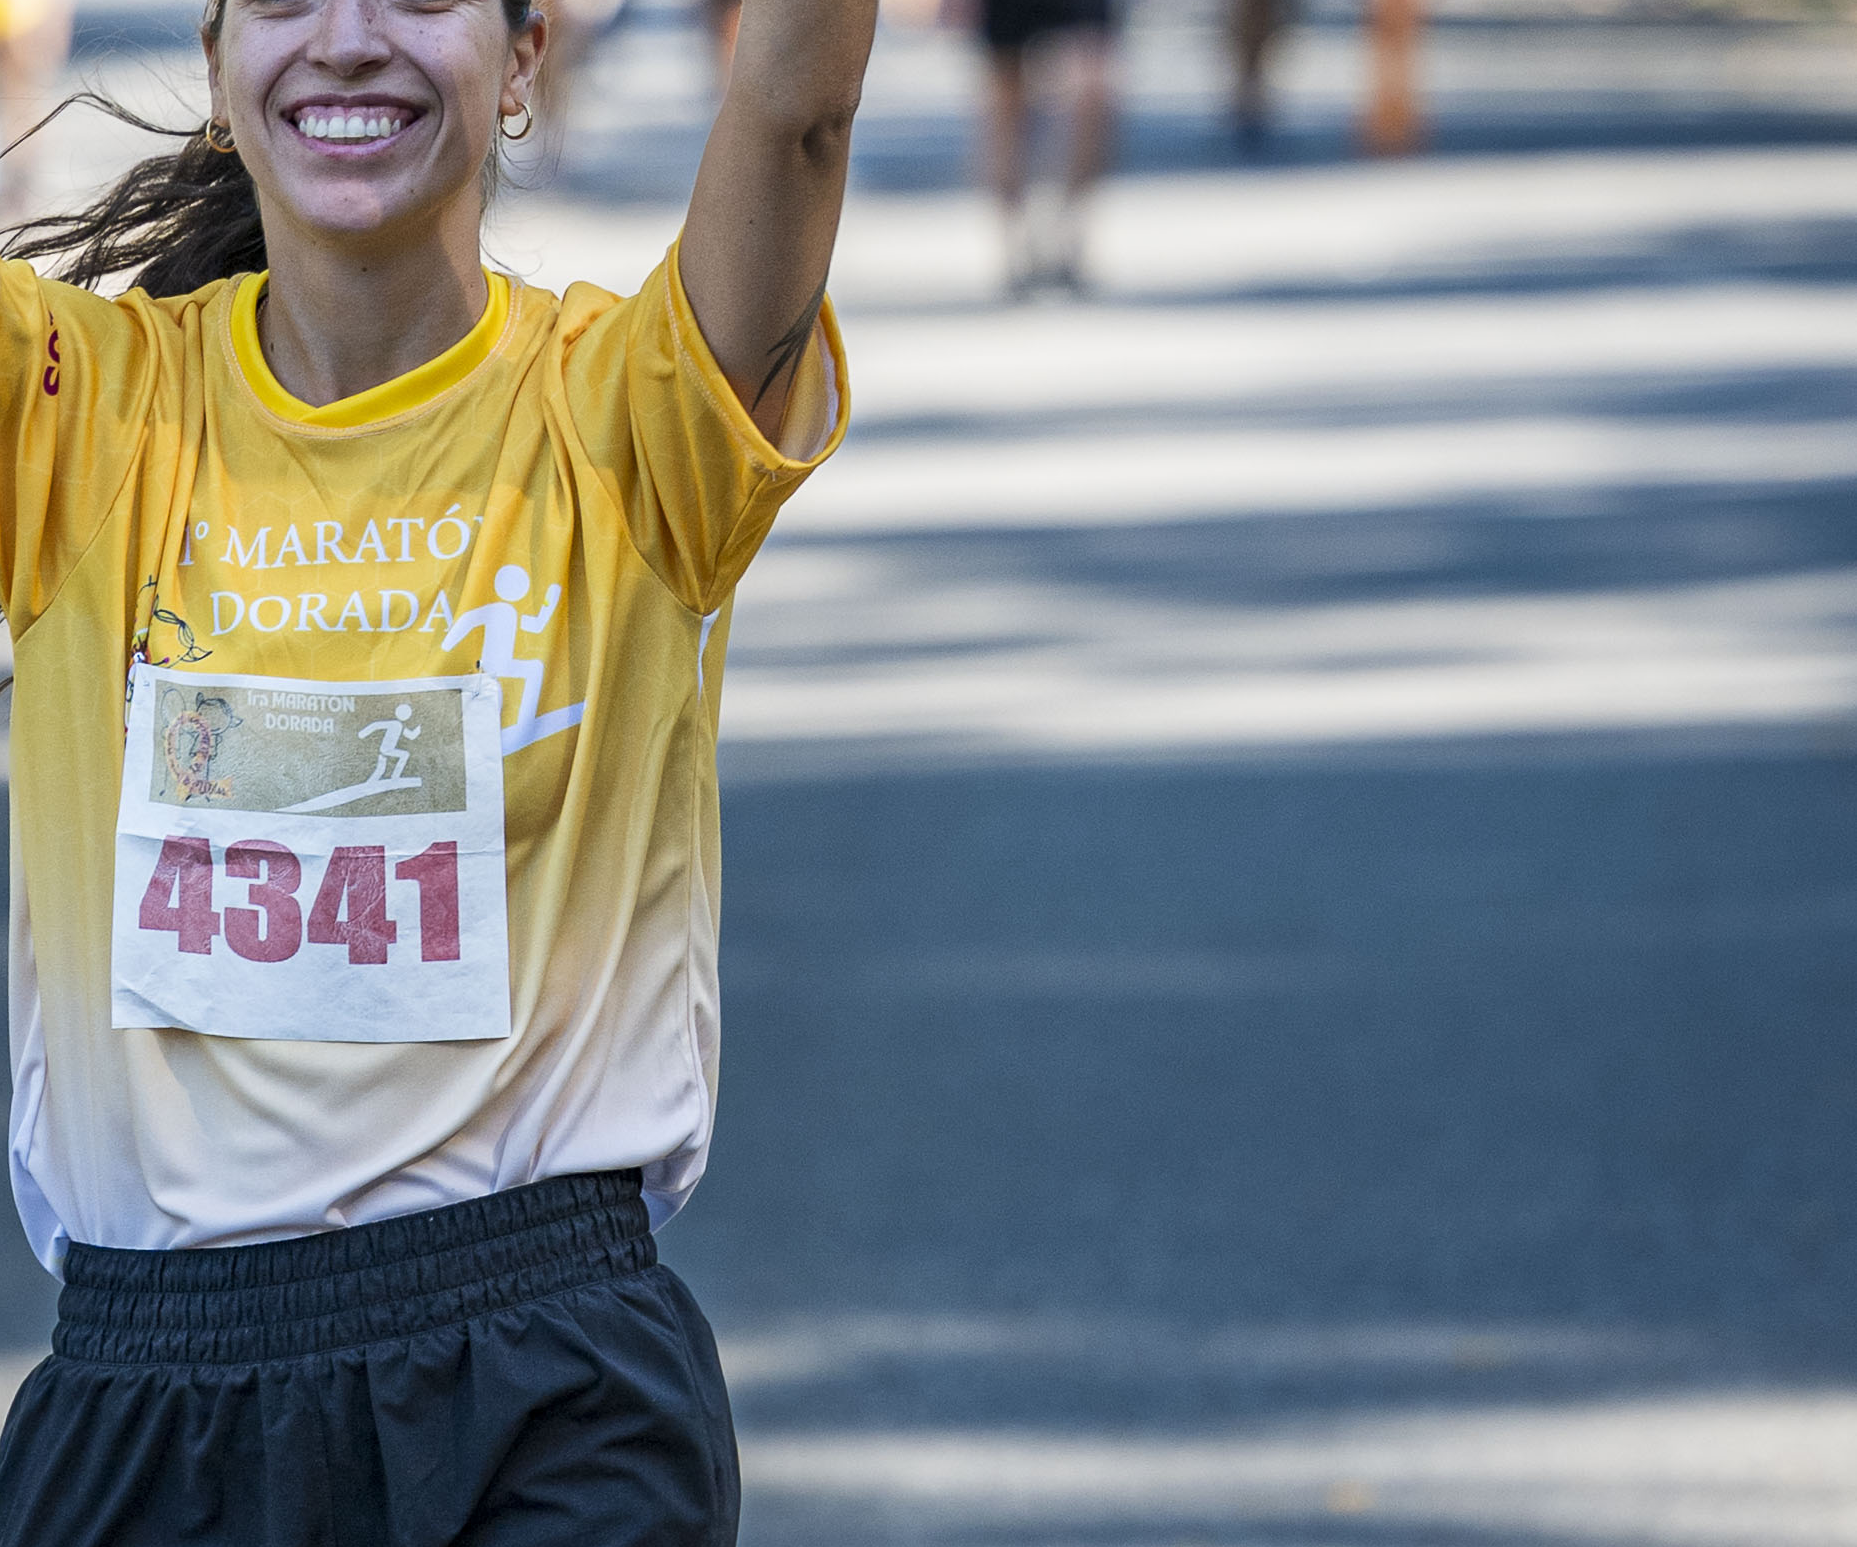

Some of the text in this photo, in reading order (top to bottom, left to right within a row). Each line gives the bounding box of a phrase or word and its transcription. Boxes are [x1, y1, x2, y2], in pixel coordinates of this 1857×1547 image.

[219, 502, 484, 570] MARATÓ
[210, 589, 457, 637] DORADA
[264, 713, 335, 734] DORADA
[139, 834, 461, 965] 4341
